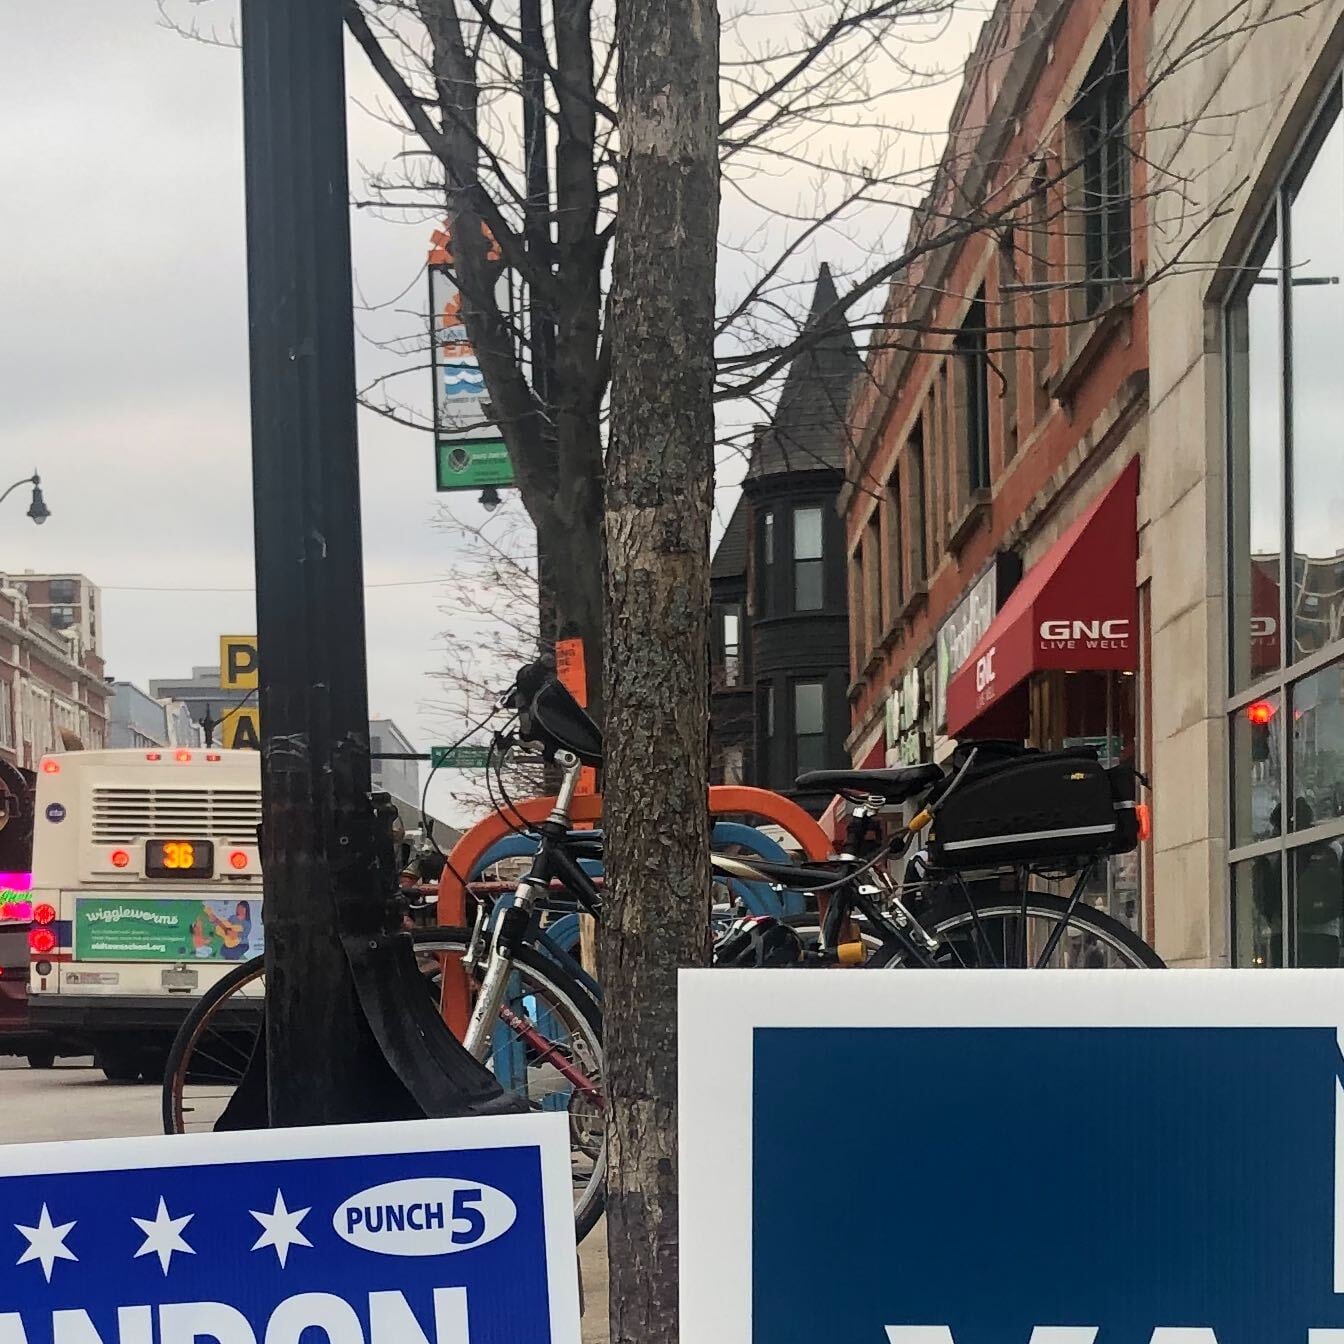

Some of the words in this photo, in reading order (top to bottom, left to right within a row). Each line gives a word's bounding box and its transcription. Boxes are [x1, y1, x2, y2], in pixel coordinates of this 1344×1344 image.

[1039, 619, 1129, 640] GNC
[1040, 641, 1076, 650] LIVE
[1086, 639, 1129, 650] WELL
[163, 842, 193, 869] 36
[86, 906, 179, 925] wiggleworms
[346, 1202, 445, 1235] PUNCH
[450, 1188, 486, 1245] 5
